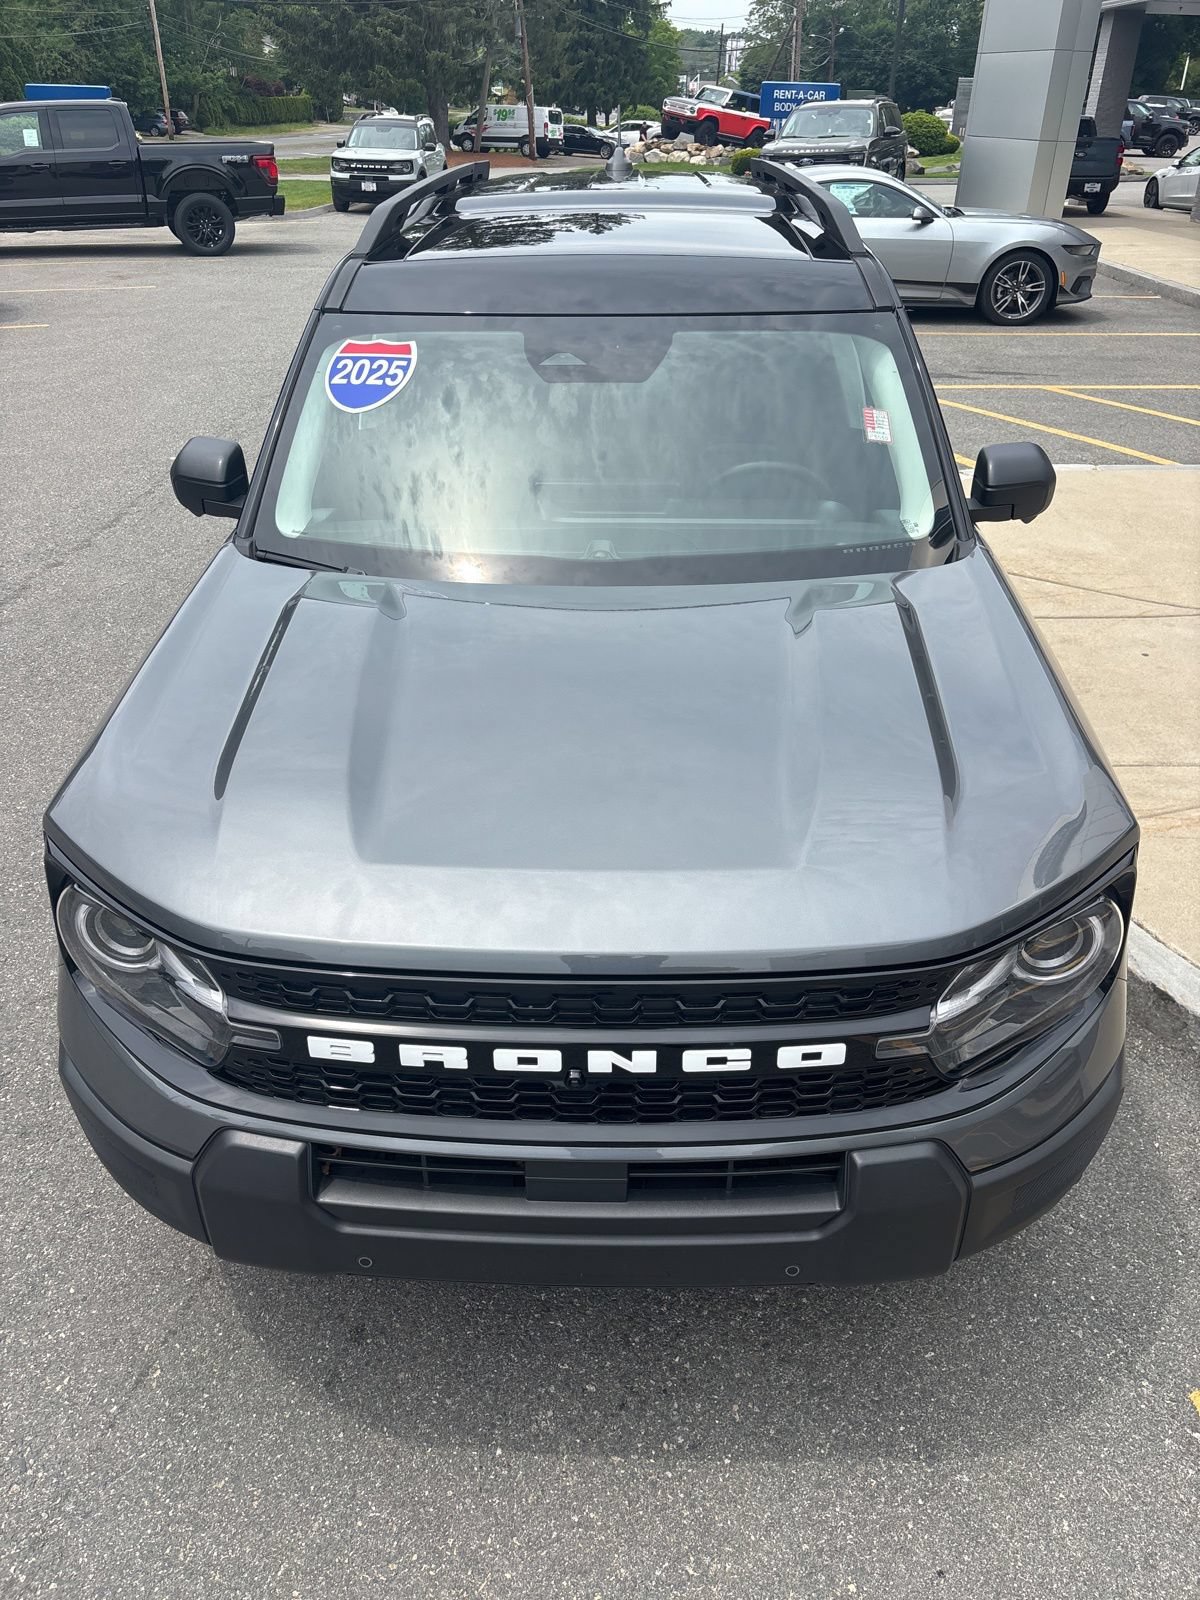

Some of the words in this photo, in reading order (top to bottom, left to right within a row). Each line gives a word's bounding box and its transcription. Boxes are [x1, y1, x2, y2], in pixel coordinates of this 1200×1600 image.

[773, 89, 826, 100] RENT-A-CAR
[774, 102, 796, 111] BODY
[331, 358, 408, 386] 2025
[307, 1036, 847, 1074] BRONCO
